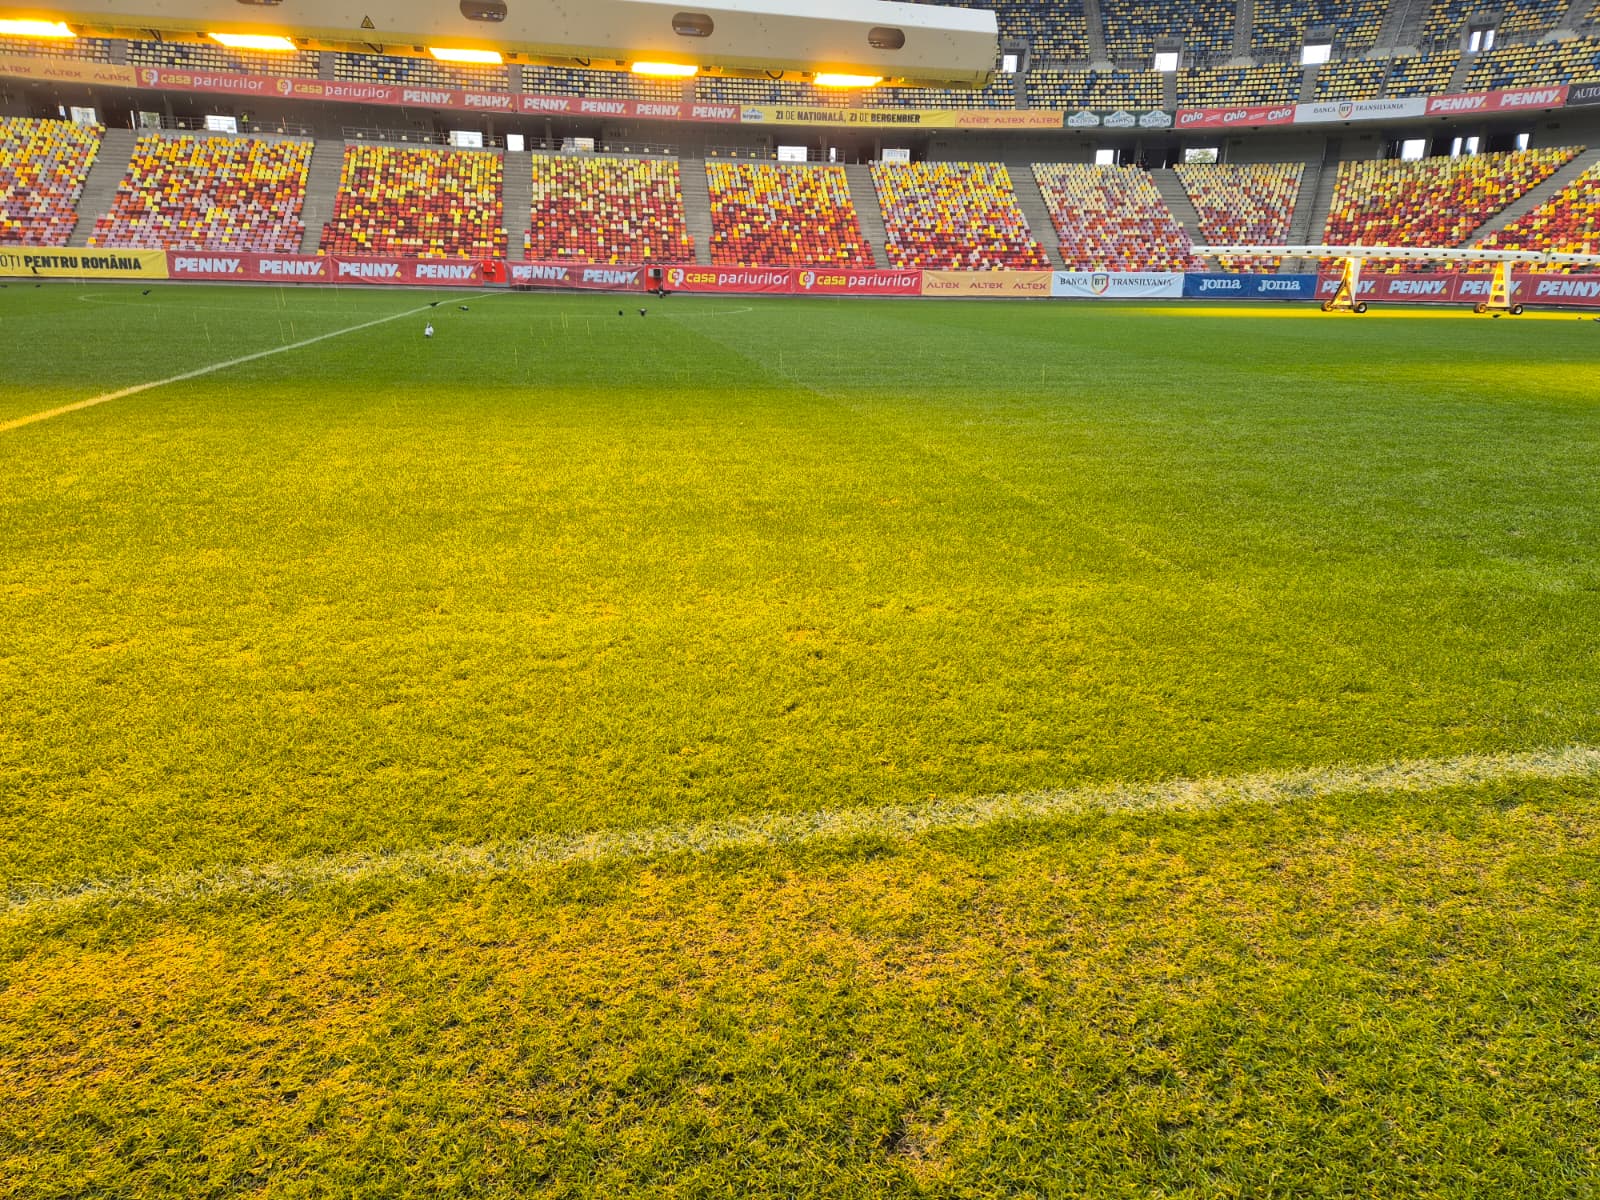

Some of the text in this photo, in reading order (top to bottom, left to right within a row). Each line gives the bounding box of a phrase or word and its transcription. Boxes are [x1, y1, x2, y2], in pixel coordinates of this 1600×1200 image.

[160, 73, 264, 90] casa pariurilor
[294, 82, 391, 99] casa pariurilor
[1181, 112, 1204, 124] Chio
[1223, 110, 1247, 122] Chio
[1267, 108, 1292, 121] Chio
[1313, 106, 1336, 114] BANCA
[1355, 103, 1404, 112] TRANSILVANIA
[776, 111, 784, 120] ZI
[785, 111, 795, 121] DE
[849, 112, 858, 122] ZI
[859, 112, 869, 122] DE
[871, 113, 921, 123] BERGENBIER
[24, 255, 79, 270] PENTRU
[82, 254, 142, 270] ROMÂNIA
[686, 270, 789, 287] casa pariurilor
[816, 270, 918, 288] casa pariurilor
[1060, 277, 1172, 287] BANCA BT TRANSILVANIA
